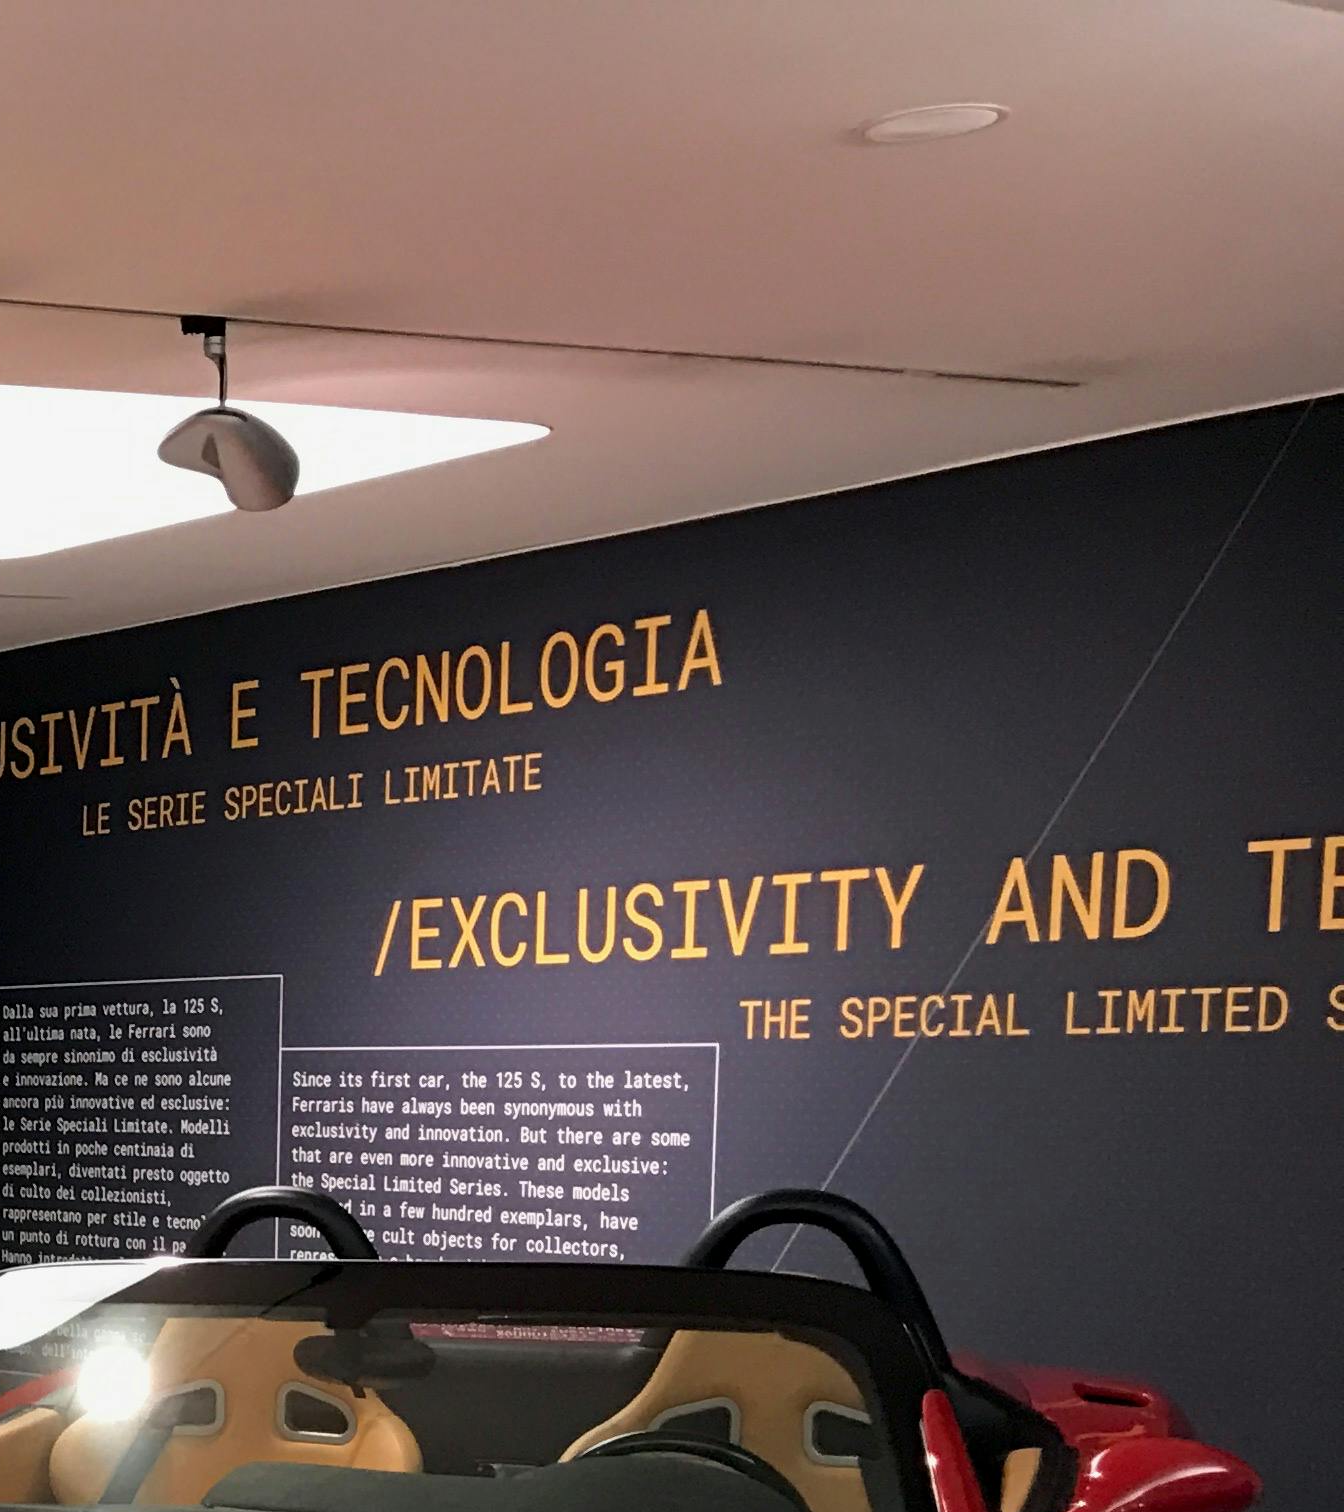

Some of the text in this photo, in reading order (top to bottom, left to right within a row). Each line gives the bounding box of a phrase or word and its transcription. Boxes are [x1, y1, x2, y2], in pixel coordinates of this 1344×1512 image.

[232, 680, 258, 748] E
[301, 609, 722, 738] TECNOLOGIA
[84, 752, 542, 835] LE SERIE SPECIALI LIMITATE
[374, 864, 924, 976] /EXCLUSIVITY
[986, 849, 1170, 944] AND
[4, 998, 223, 1020] Dalla sua prima vettura, la 125 S,
[739, 999, 812, 1040] THE
[840, 993, 1030, 1038] SPECIAL
[1066, 987, 1288, 1034] LIMITED
[4, 1024, 211, 1041] all'ultima nata, le Ferrari sono
[3, 1046, 217, 1066] da sempre sinonimo di esclusività
[3, 1070, 231, 1086] e innovazione. Ma ce ne sono alcune
[293, 1070, 689, 1092] Since its first car, the 125 S, to the latest,
[3, 1094, 229, 1111] ancora più innovative ed esclusive:
[293, 1096, 642, 1121] Ferraris have always been synonymous with
[4, 1116, 230, 1135] le Serie Speciali Limitate. Modelli
[292, 1121, 691, 1147] exclusivity and innovation. But there are some
[3, 1140, 195, 1158] prodotti in poche centinaia di
[292, 1146, 668, 1175] that are even more innovative and exclusive:
[3, 1161, 230, 1186] esemplari, diventati presto oggetto
[3, 1184, 171, 1207] di culto dei collezionisti,
[291, 1173, 630, 1202] the Special Limited Series. These models
[3, 1209, 206, 1230] rappresentano per stile e tecno
[360, 1200, 375, 1216] in
[383, 1205, 391, 1217] a
[399, 1201, 425, 1219] few
[432, 1203, 492, 1223] hundred
[500, 1208, 588, 1231] exemplars,
[600, 1211, 638, 1231] have
[3, 1230, 165, 1251] un punto di rottura con il
[382, 1227, 415, 1245] cult
[423, 1229, 483, 1251] objects
[491, 1232, 517, 1251] for
[526, 1235, 624, 1261] collectors,
[1, 1250, 32, 1264] Hanno
